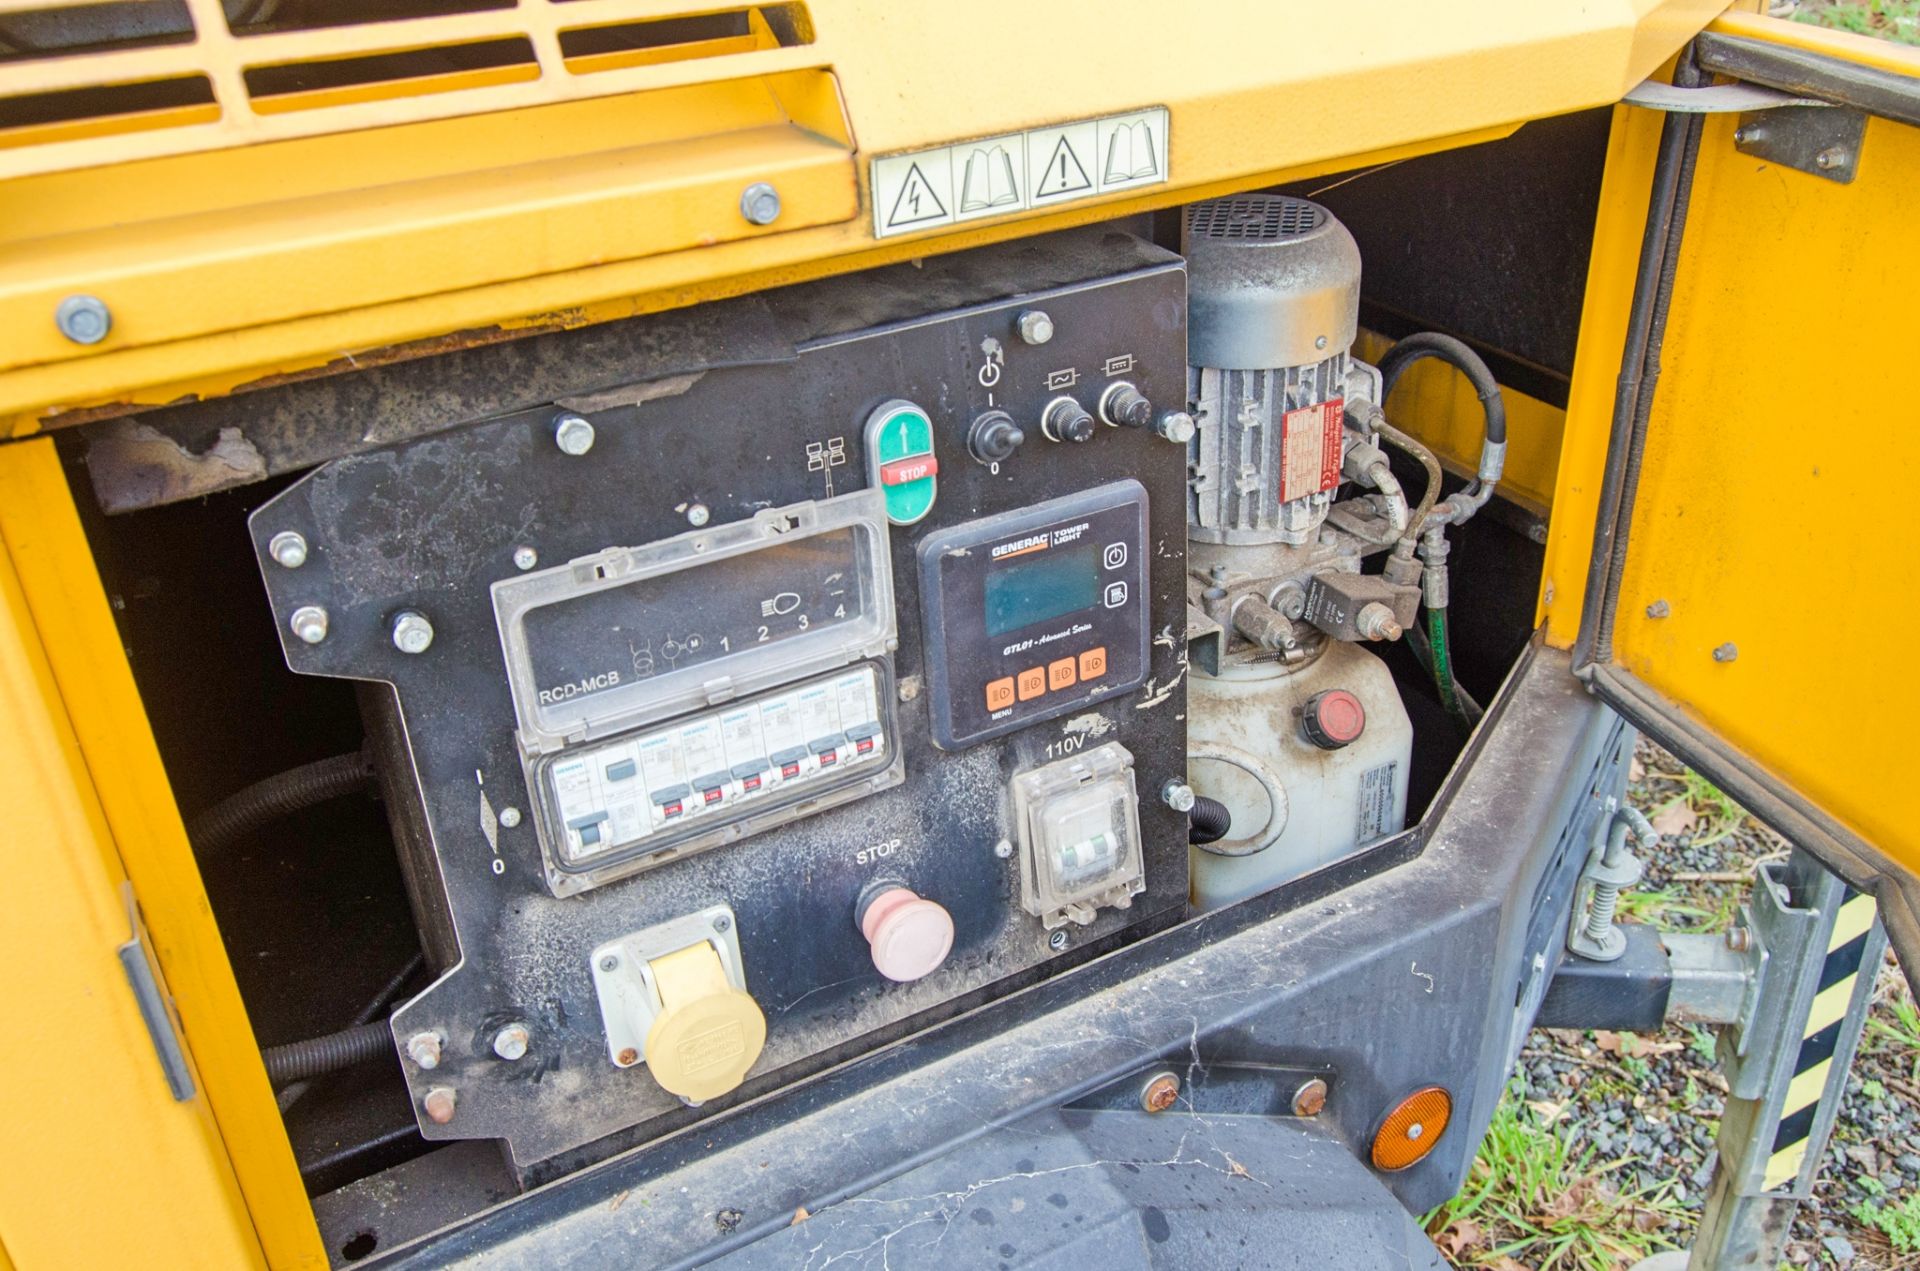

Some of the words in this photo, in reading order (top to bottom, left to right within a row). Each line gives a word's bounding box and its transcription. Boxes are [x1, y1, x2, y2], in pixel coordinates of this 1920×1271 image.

[900, 465, 927, 482] STOP
[1054, 522, 1089, 536] TOWER
[1054, 532, 1082, 545] LIGHT
[992, 534, 1049, 557] GENERAC
[720, 636, 730, 652] 1
[758, 626, 770, 642] 2
[798, 614, 809, 630] 3
[834, 604, 846, 619] 4
[1003, 639, 1034, 656] GTL01
[1038, 630, 1071, 646] Advanced
[1072, 623, 1092, 634] Series
[538, 671, 620, 704] RCD-MCB
[992, 708, 1012, 720] MENU
[1046, 733, 1086, 759] 110V
[856, 838, 900, 865] STOP
